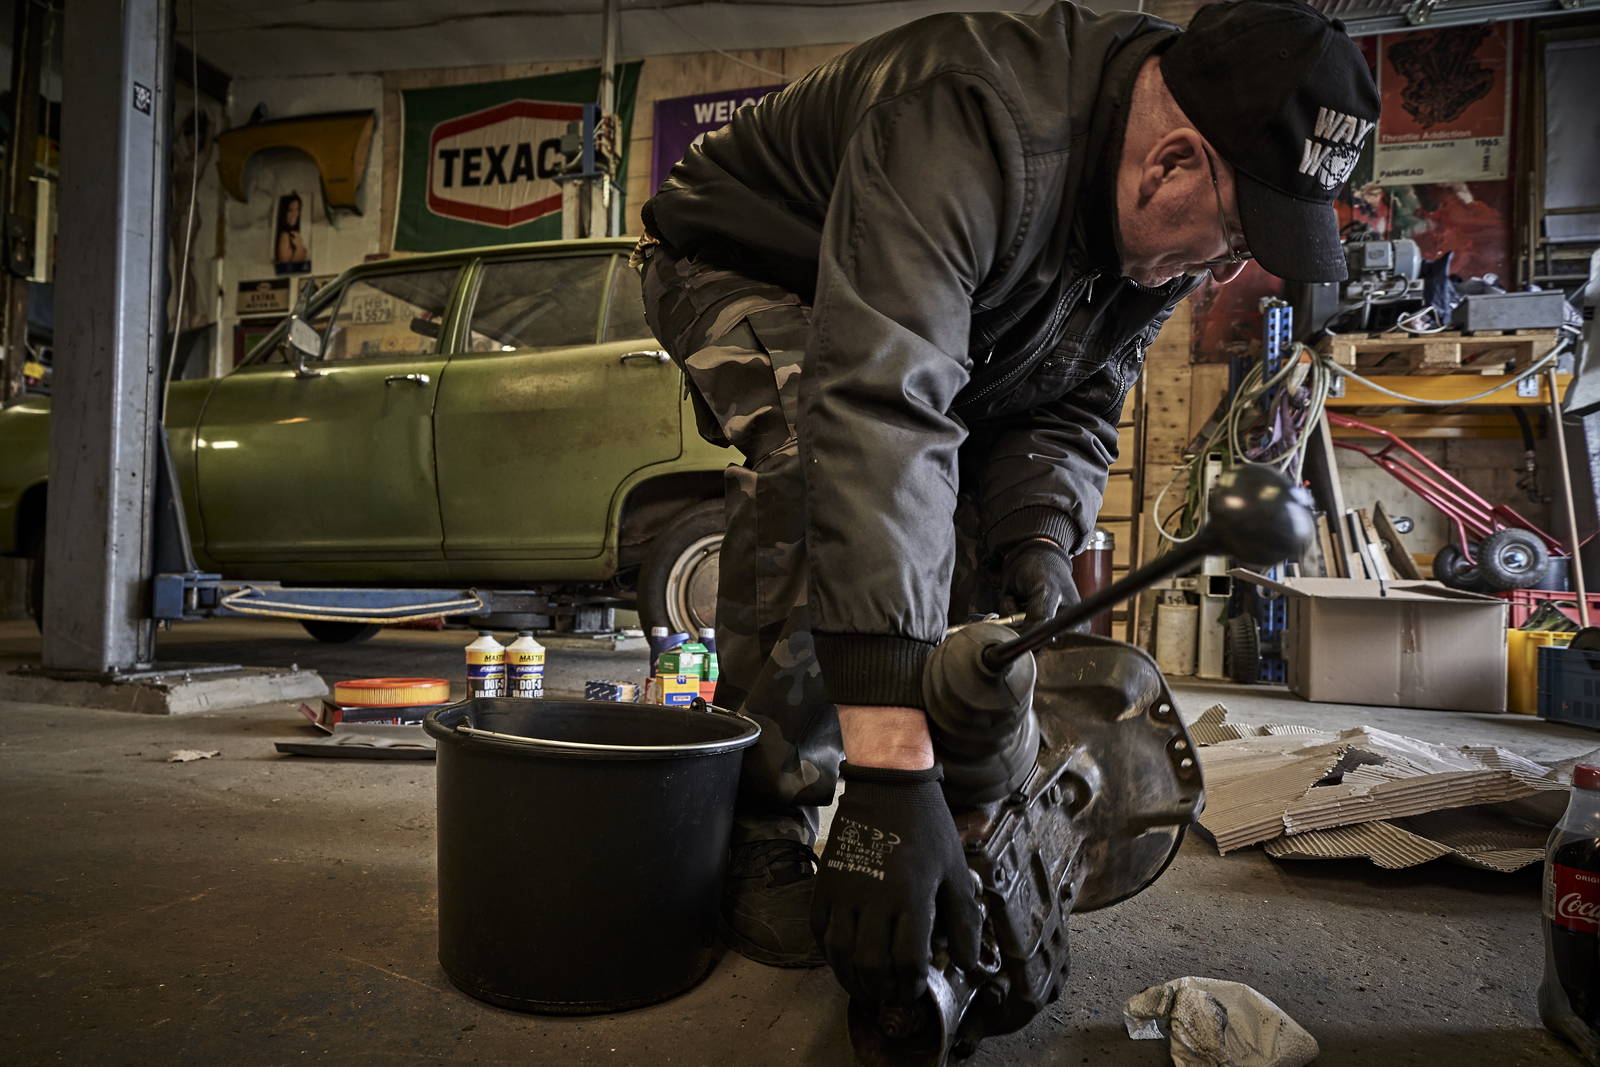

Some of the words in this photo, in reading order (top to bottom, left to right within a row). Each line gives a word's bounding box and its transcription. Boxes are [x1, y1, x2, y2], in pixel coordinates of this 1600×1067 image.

[1313, 105, 1376, 146] WAY
[1422, 129, 1472, 140] Addiction
[1431, 141, 1455, 149] PARTS
[439, 138, 563, 188] TEXAC
[1380, 168, 1424, 177] PANHEAD
[827, 859, 886, 881] Work-Inn
